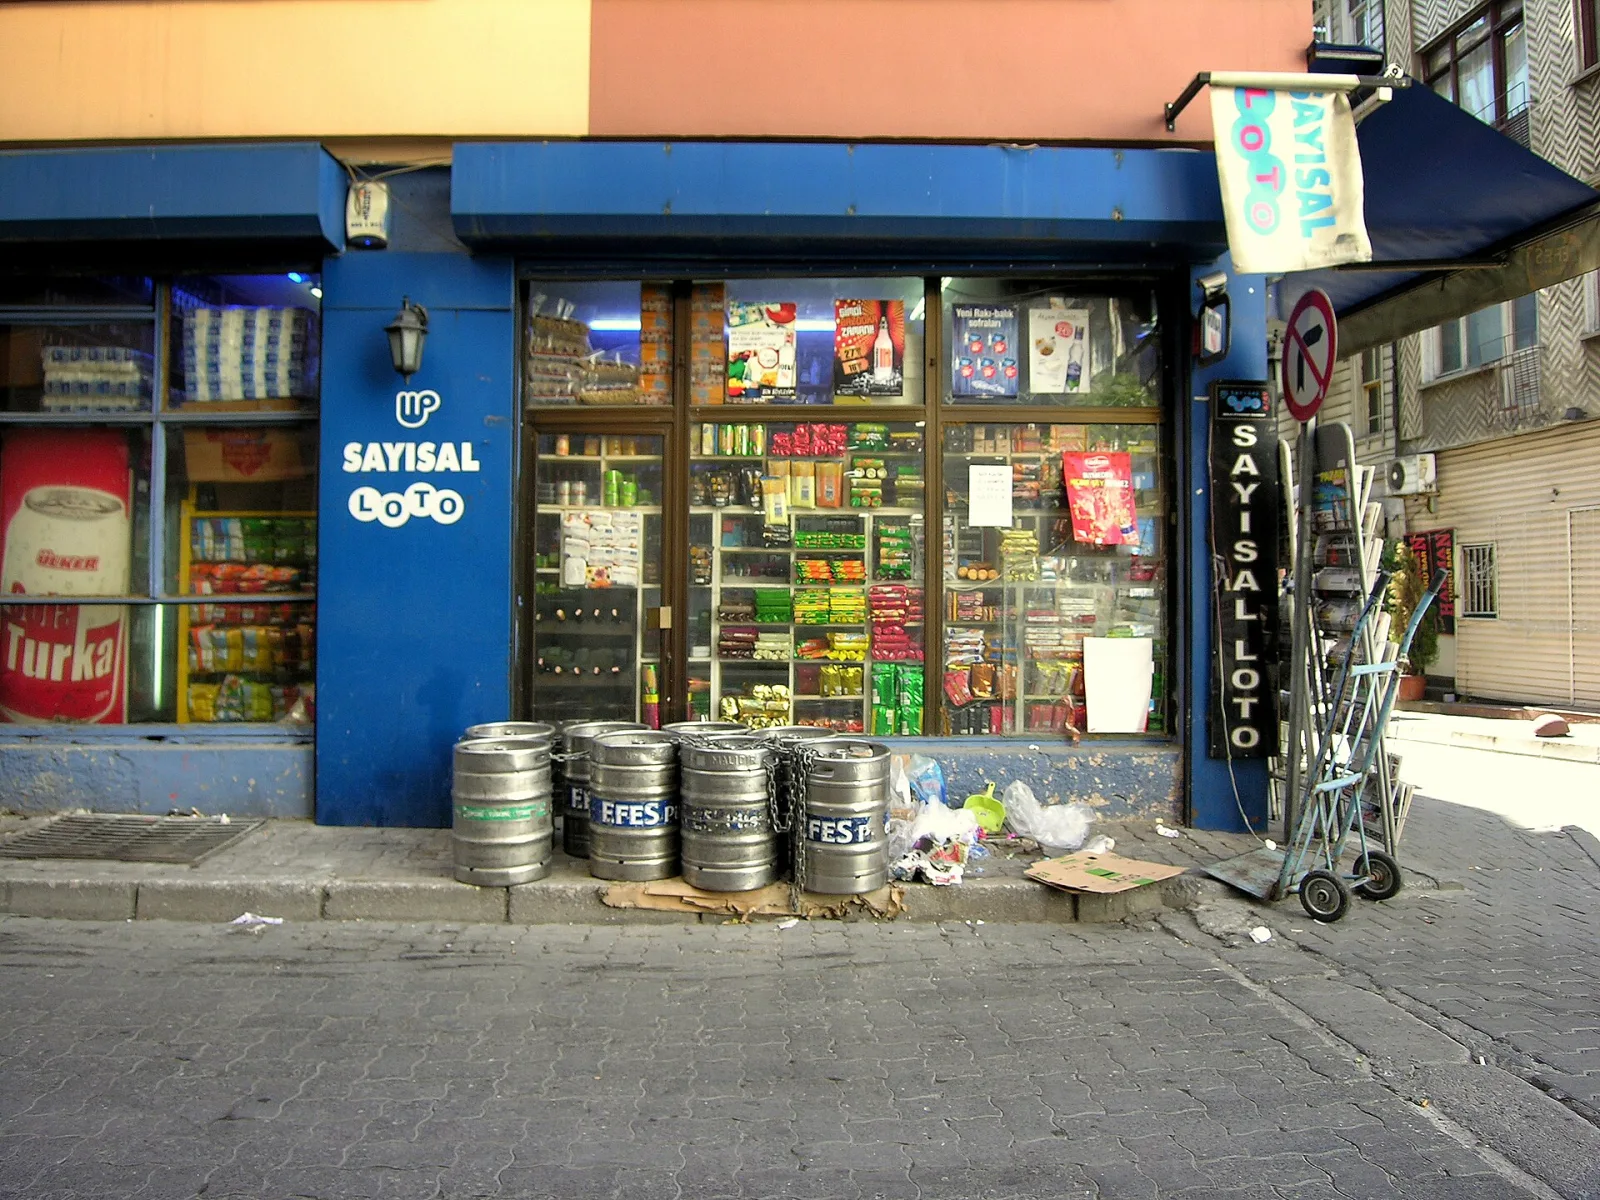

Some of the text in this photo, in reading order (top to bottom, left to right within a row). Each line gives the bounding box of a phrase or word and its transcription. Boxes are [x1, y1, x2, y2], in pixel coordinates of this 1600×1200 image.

[1237, 87, 1284, 231] LOTO
[955, 308, 973, 319] Yeni
[342, 442, 480, 473] SAYISAL
[353, 486, 460, 522] LOTO
[1231, 424, 1259, 621] SAYISAL
[37, 549, 99, 571] ÜLKER
[7, 620, 114, 682] Turka
[1231, 639, 1260, 750] LOTO
[601, 801, 660, 826] EFES
